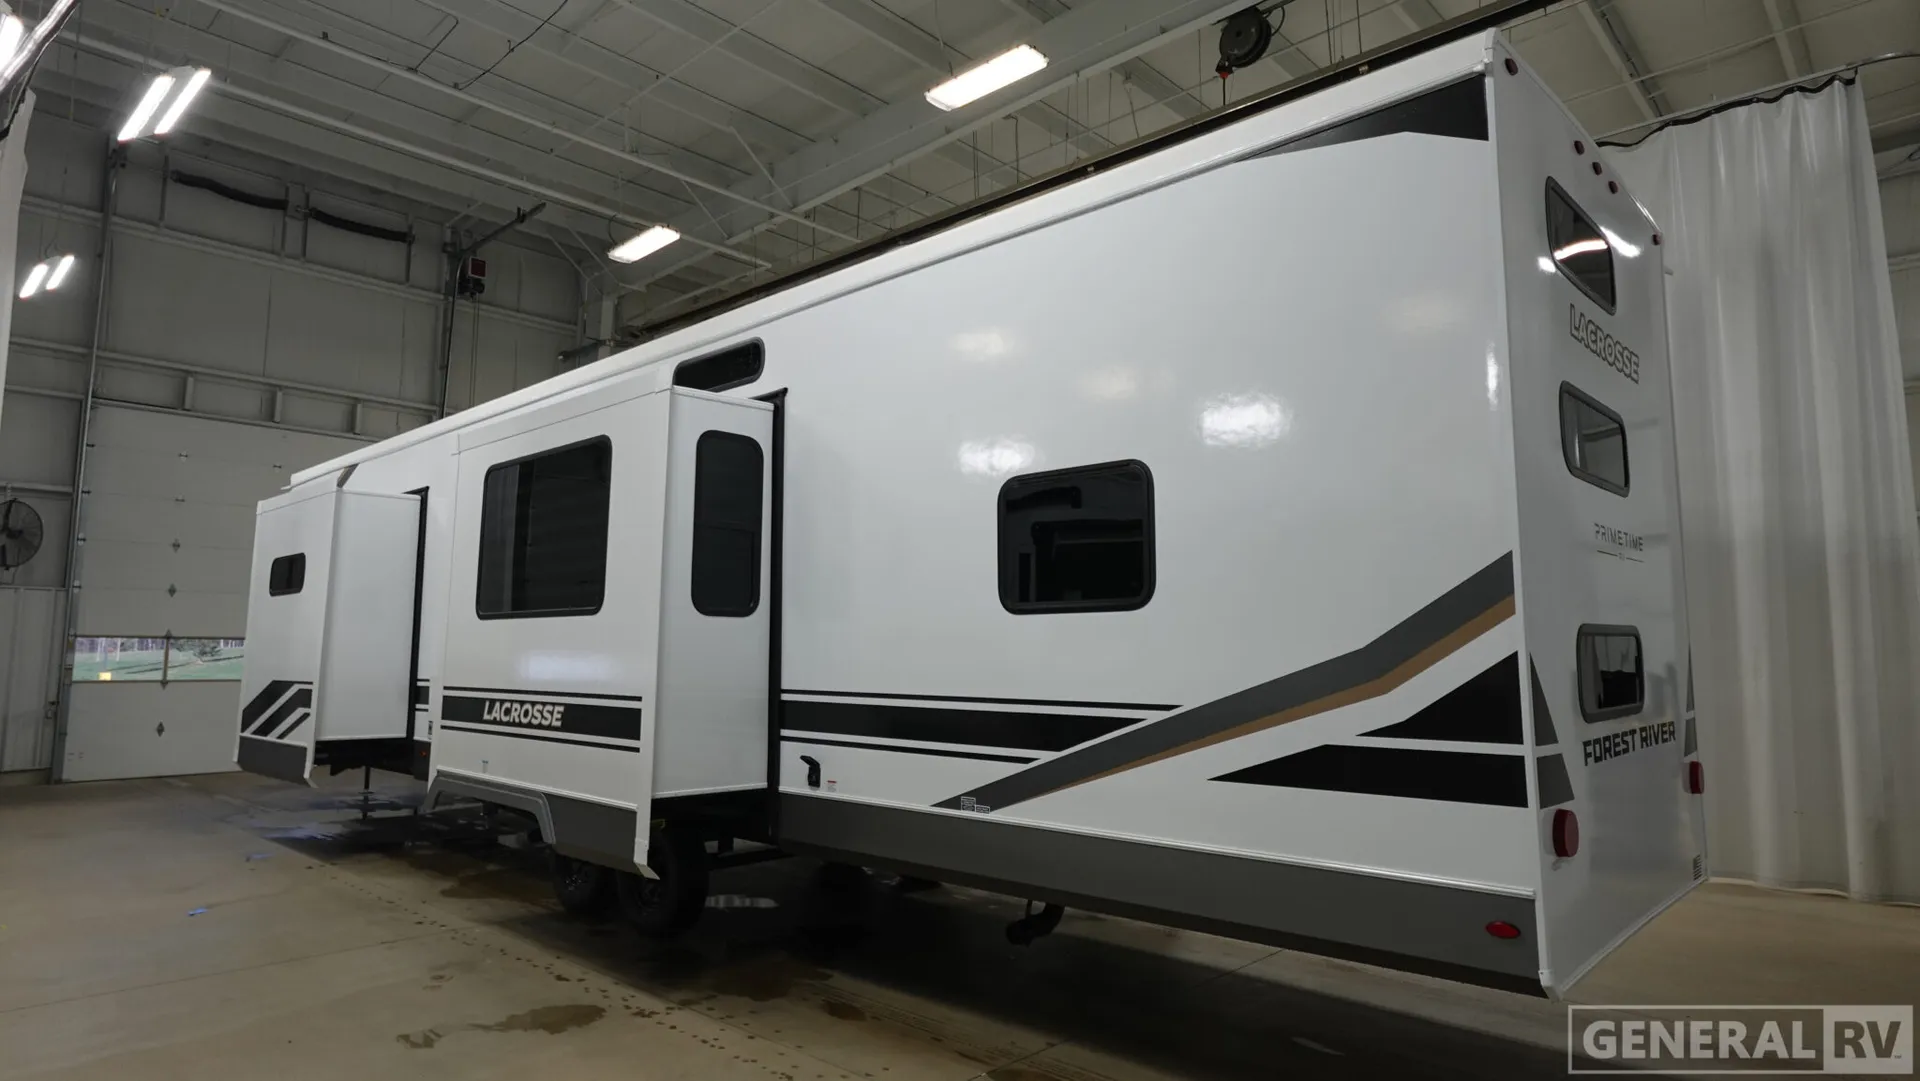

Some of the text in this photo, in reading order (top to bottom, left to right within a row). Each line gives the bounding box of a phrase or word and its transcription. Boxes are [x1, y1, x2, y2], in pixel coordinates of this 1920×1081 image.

[1569, 303, 1640, 385] LACROSSE
[483, 700, 565, 727] LACROSSE
[1582, 721, 1676, 767] FOREST RIVER
